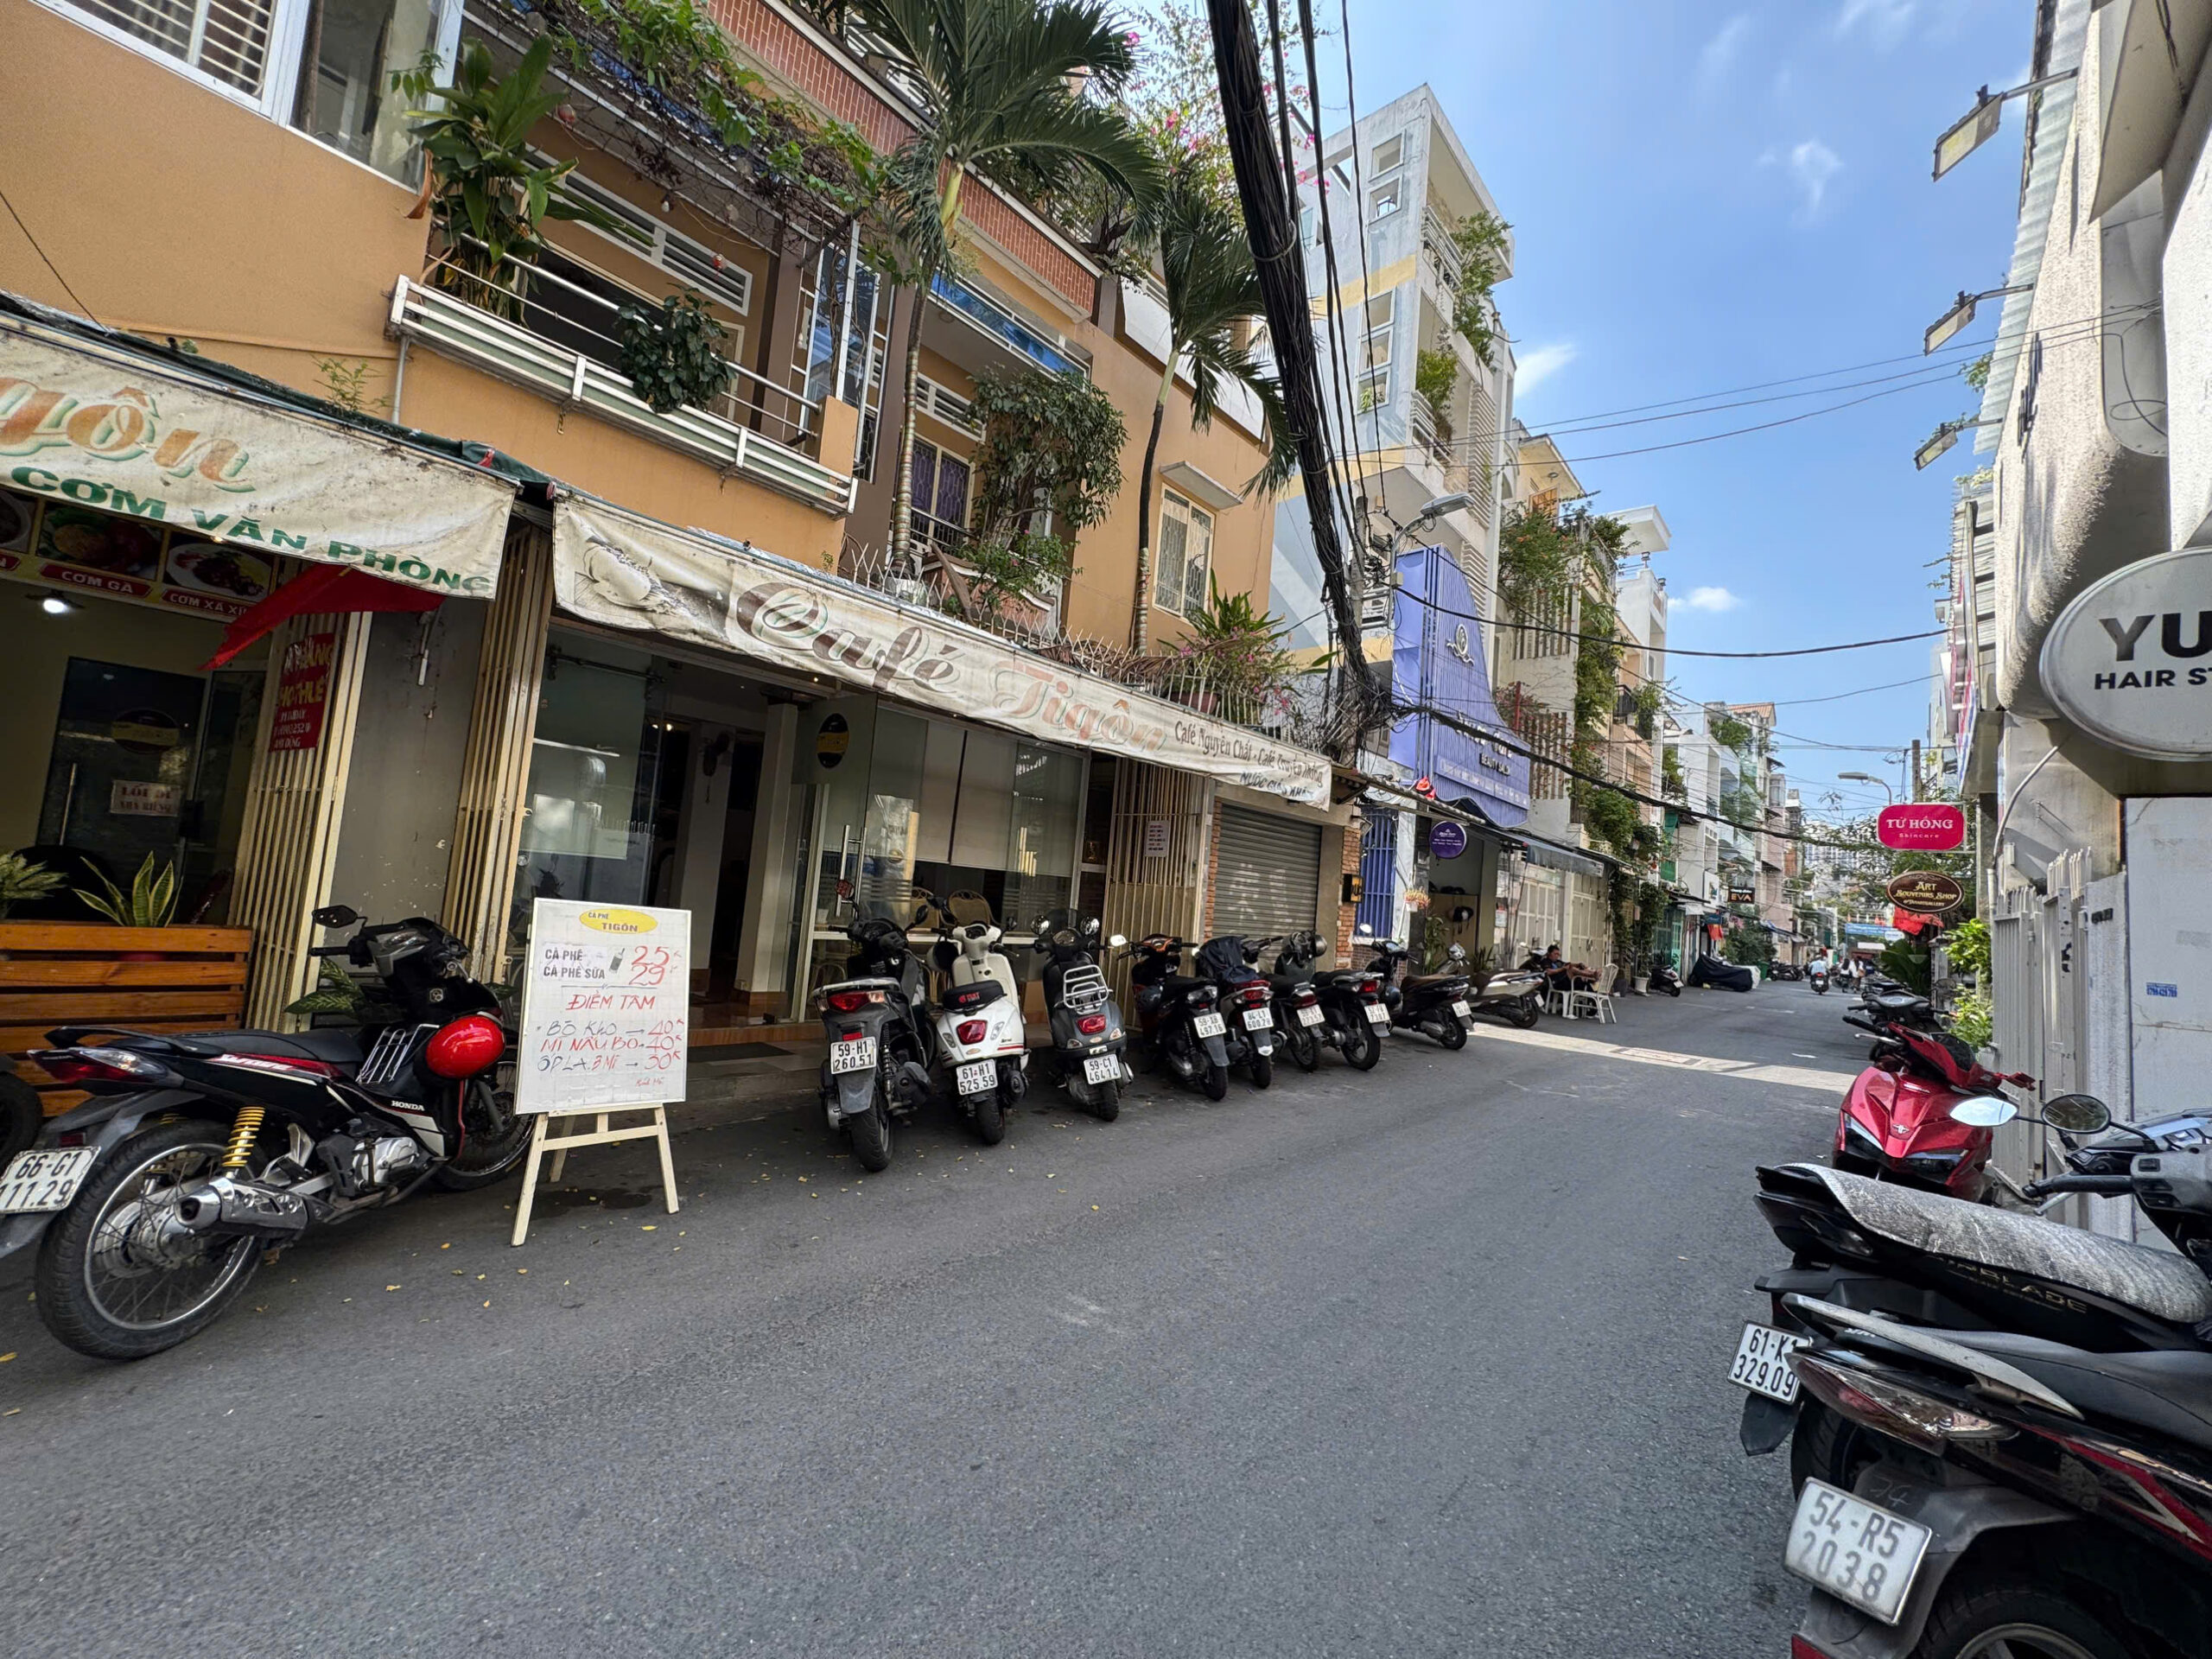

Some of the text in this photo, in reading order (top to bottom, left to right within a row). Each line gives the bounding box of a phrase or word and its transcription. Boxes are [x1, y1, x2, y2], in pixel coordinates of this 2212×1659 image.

[10, 467, 491, 593] CƠM VĂN PHÒNG
[61, 571, 133, 594] CƠM GÀ
[736, 582, 962, 693] Café
[2094, 670, 2176, 690] HAIR
[1174, 720, 1197, 745] Café
[1198, 728, 1231, 757] Nguyên
[1258, 747, 1276, 768] Café
[1731, 893, 1752, 902] EVA
[545, 947, 583, 962] CÀ PHÊ
[543, 965, 606, 979] CÀ PHÊ SỮA
[838, 1040, 868, 1058] 59-H1
[1089, 1058, 1112, 1071] 59-C1
[391, 1100, 425, 1111] HONDA
[16, 1152, 82, 1179] 66-G1
[1749, 1328, 1798, 1363] 61-K
[1733, 1354, 1796, 1397] 329.09
[1809, 1491, 1905, 1560] 54-R5
[1797, 1530, 1888, 1603] 2038
